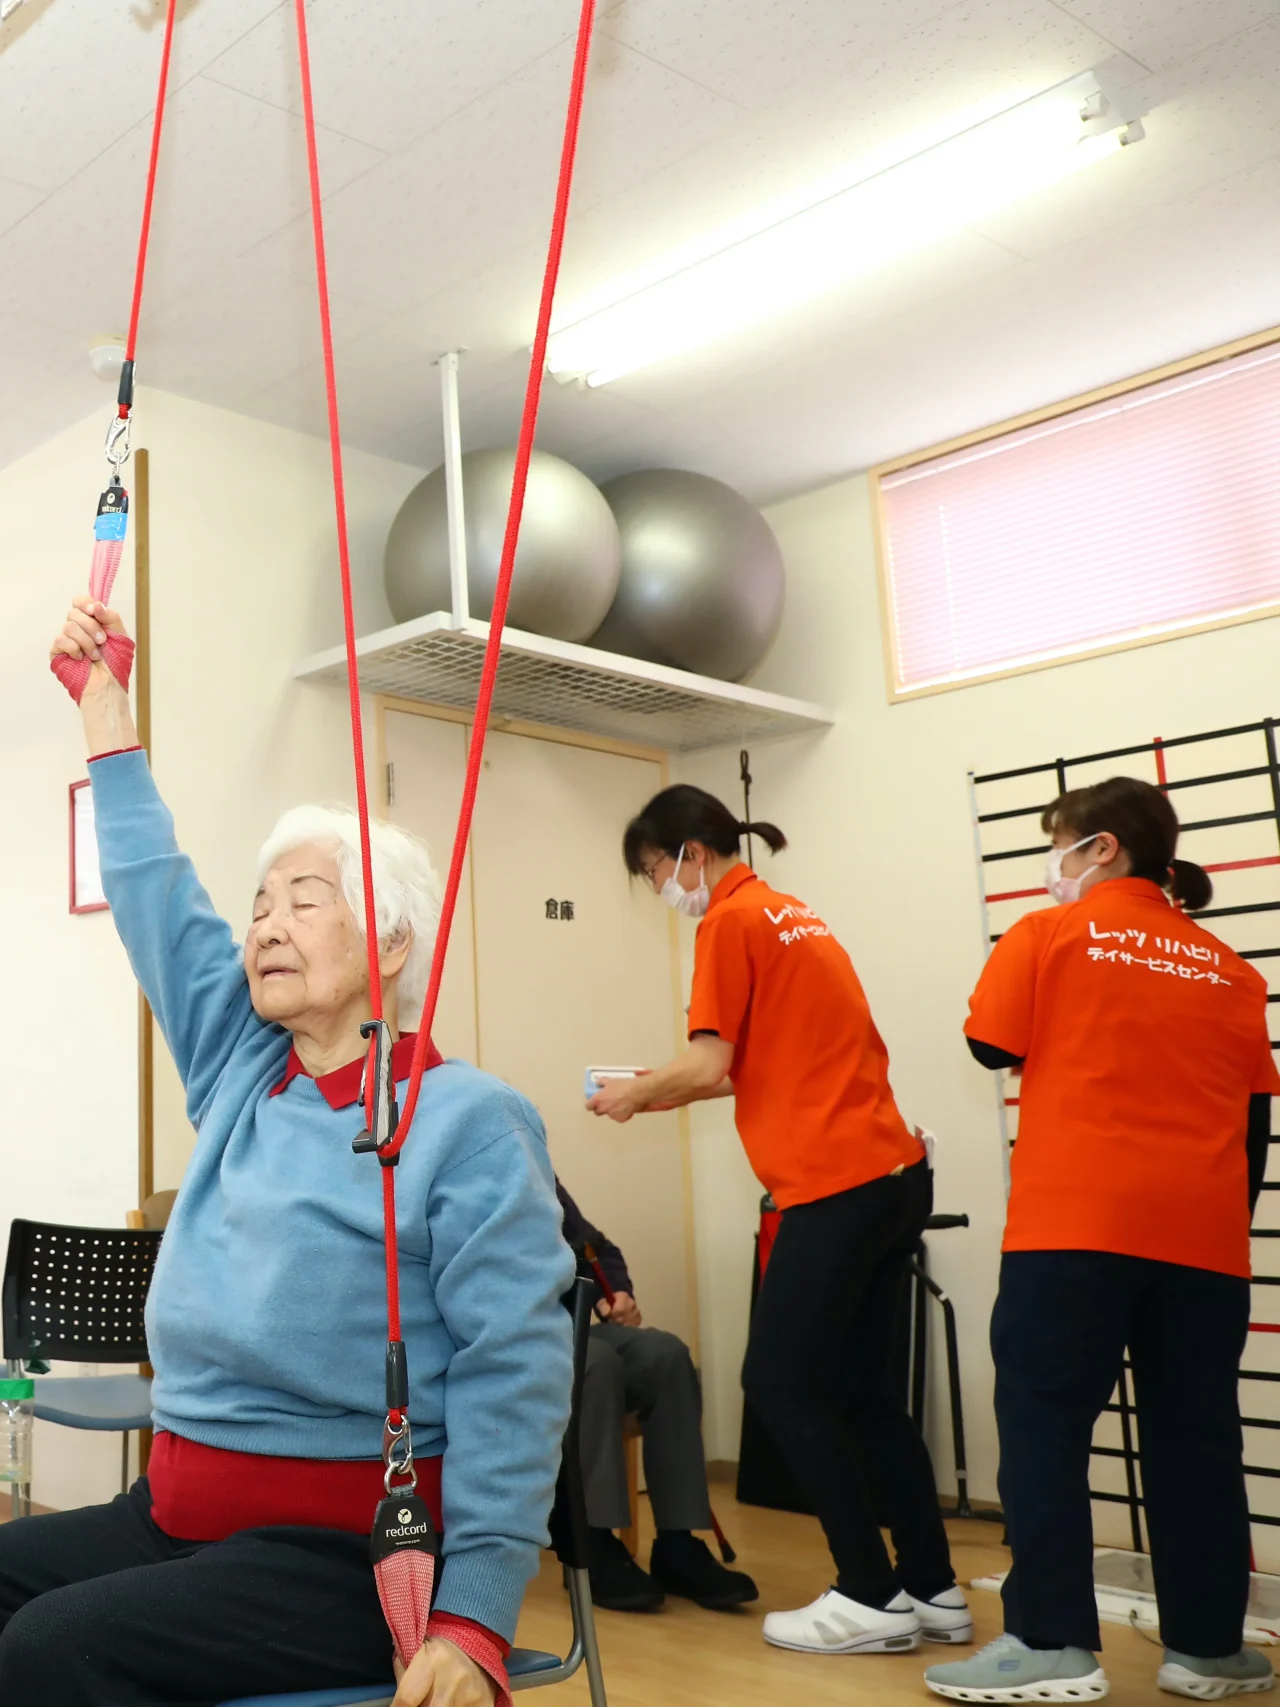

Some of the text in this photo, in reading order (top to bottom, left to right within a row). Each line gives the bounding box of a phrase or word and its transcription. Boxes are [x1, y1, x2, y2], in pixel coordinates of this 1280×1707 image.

[545, 898, 574, 921] 倉庫
[1088, 921, 1220, 966] レッツ リハビリ
[1086, 947, 1232, 986] デイサービスセンター
[386, 1522, 427, 1537] redcord
